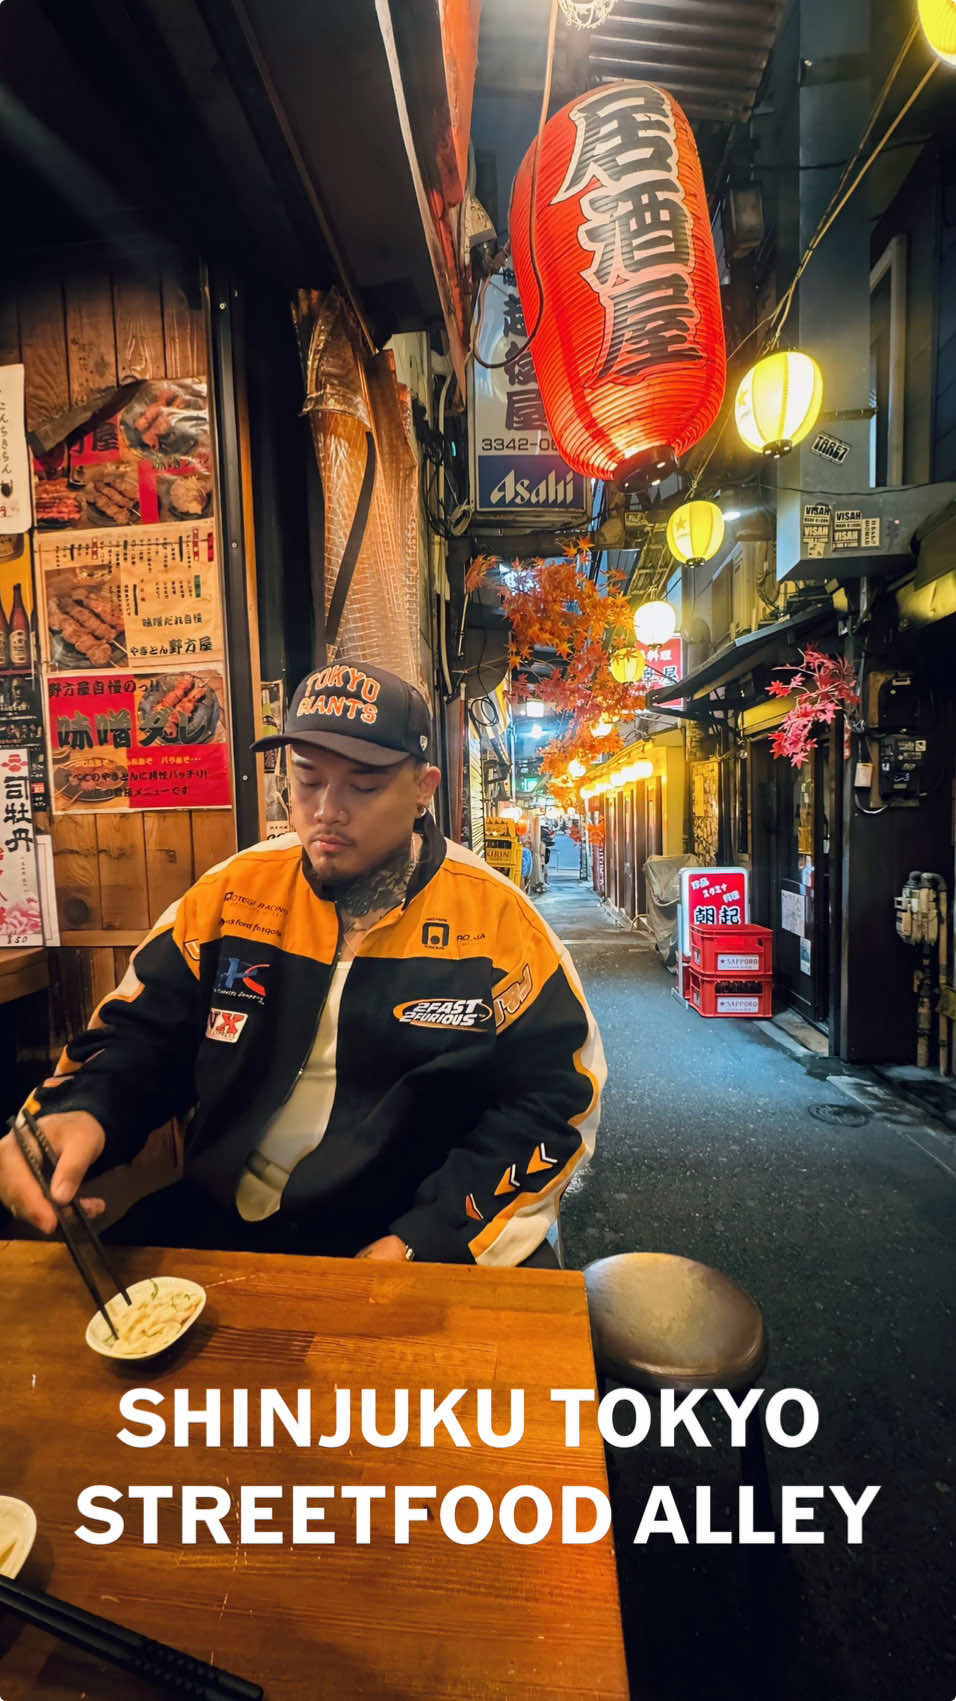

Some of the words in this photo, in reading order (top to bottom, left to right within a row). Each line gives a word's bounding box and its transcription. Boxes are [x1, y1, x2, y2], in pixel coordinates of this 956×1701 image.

[553, 83, 706, 388] 居酒屋
[489, 469, 575, 505] Asahi
[304, 664, 381, 702] TOKYO
[297, 694, 379, 724] GIANTS
[3, 775, 35, 852] 司牡丹
[400, 1012, 477, 1027] 2FURIOUS
[413, 999, 483, 1014] 2FAST
